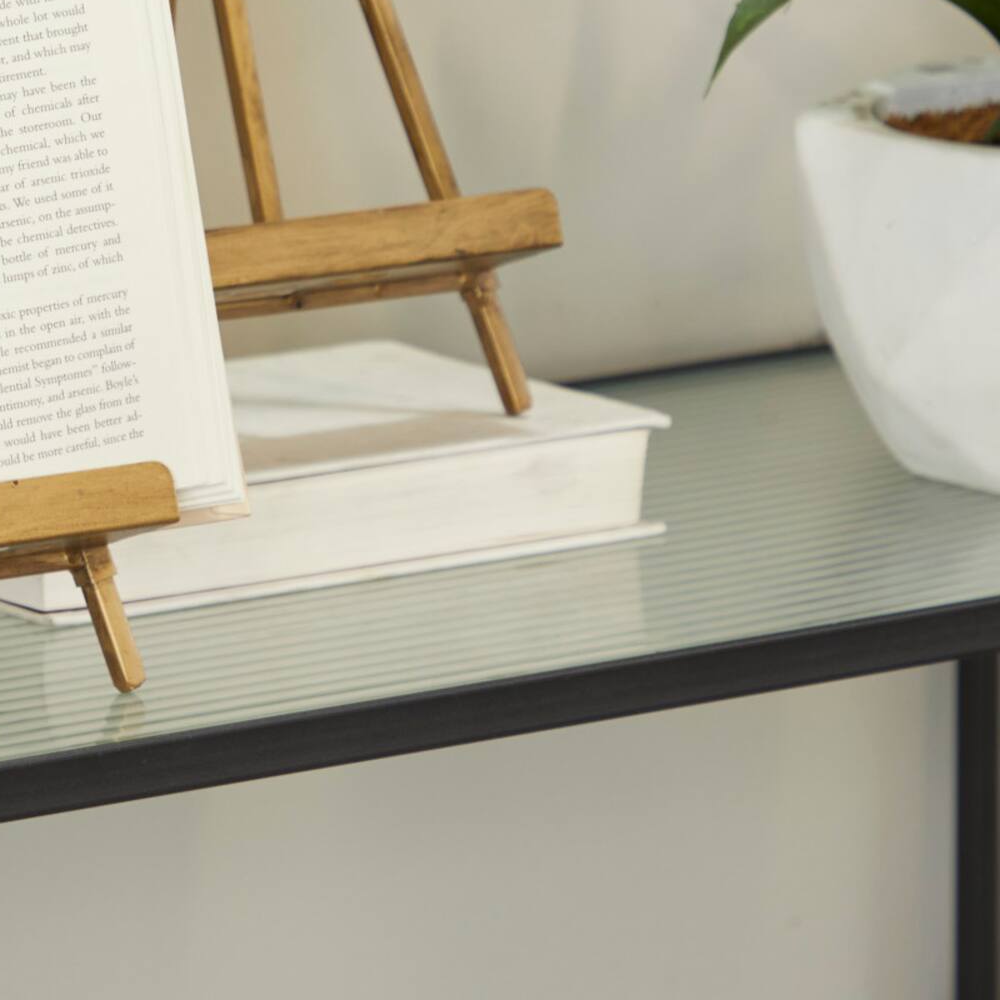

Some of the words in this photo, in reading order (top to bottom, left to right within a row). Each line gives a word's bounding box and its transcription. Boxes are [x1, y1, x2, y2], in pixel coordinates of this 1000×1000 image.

[52, 3, 85, 19] would
[45, 22, 88, 39] brought
[21, 86, 46, 97] have
[21, 97, 72, 115] chemicals
[54, 130, 87, 146] which
[17, 155, 50, 171] friend
[31, 174, 68, 187] arsenic
[70, 162, 110, 180] trioxide
[34, 190, 58, 204] used
[61, 188, 87, 199] some
[16, 225, 63, 244] chemical
[0, 250, 32, 266] bottle
[55, 240, 97, 256] mercury
[18, 301, 70, 320] properties
[86, 289, 127, 304] mercury
[14, 330, 87, 354] recommended
[31, 357, 62, 370] began
[77, 343, 123, 360] complain
[16, 413, 53, 427] remove
[94, 416, 122, 429] better
